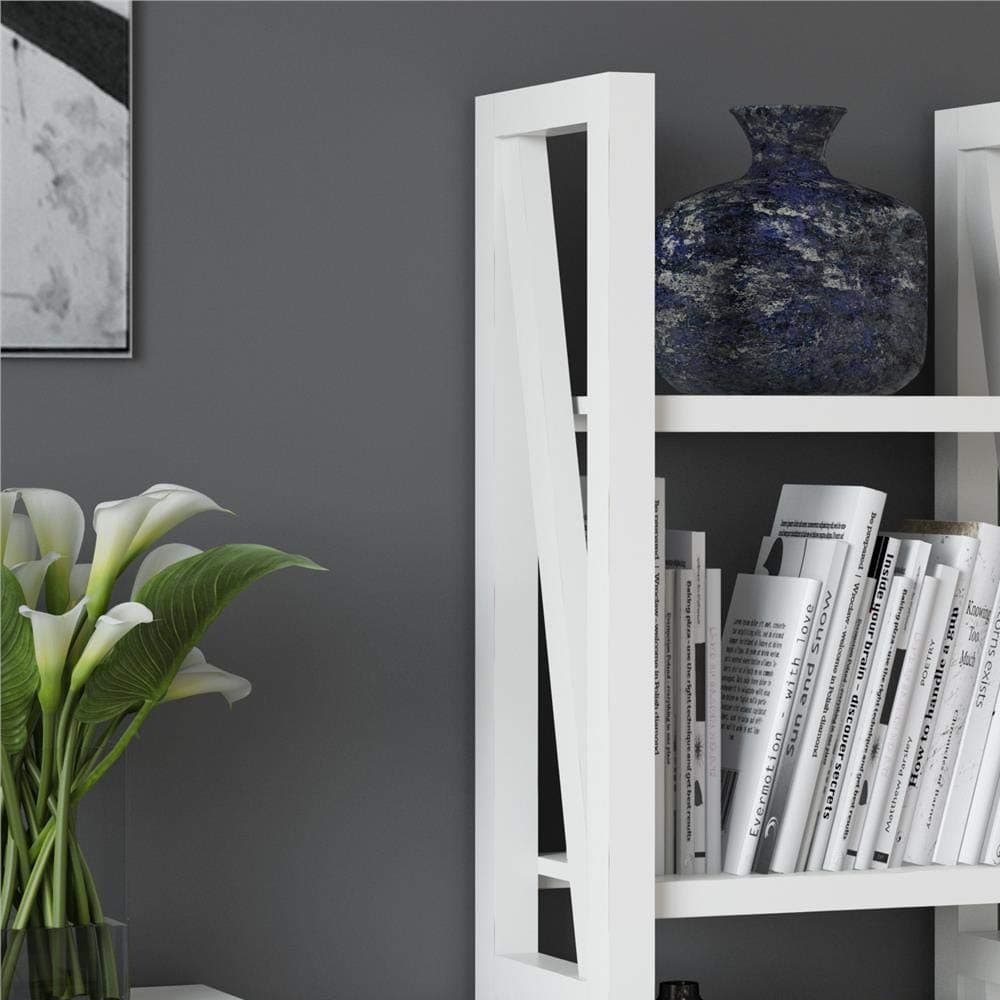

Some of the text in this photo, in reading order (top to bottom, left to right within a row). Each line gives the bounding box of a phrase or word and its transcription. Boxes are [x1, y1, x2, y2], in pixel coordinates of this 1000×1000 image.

[870, 512, 877, 525] Be
[858, 526, 872, 570] prepared
[877, 554, 894, 599] Inside
[845, 583, 860, 625] Wroclaw
[868, 601, 881, 639] your
[947, 607, 959, 641] gun
[833, 631, 847, 674] welcome
[857, 641, 873, 680] brain
[920, 639, 935, 686] POETRY
[943, 645, 950, 654] a
[823, 686, 835, 714] Polish
[830, 675, 837, 685] in
[924, 659, 945, 719] handle
[976, 660, 992, 707] exists
[750, 733, 785, 837] Evermotion
[785, 657, 802, 699] with
[797, 604, 816, 645] love
[786, 714, 802, 757] Sun
[800, 663, 815, 706] and
[838, 695, 859, 760] discover
[812, 715, 826, 758] diamond
[920, 724, 930, 741] to
[885, 736, 913, 833] Matthew Parsley
[908, 746, 924, 787] How
[823, 763, 842, 819] secrets
